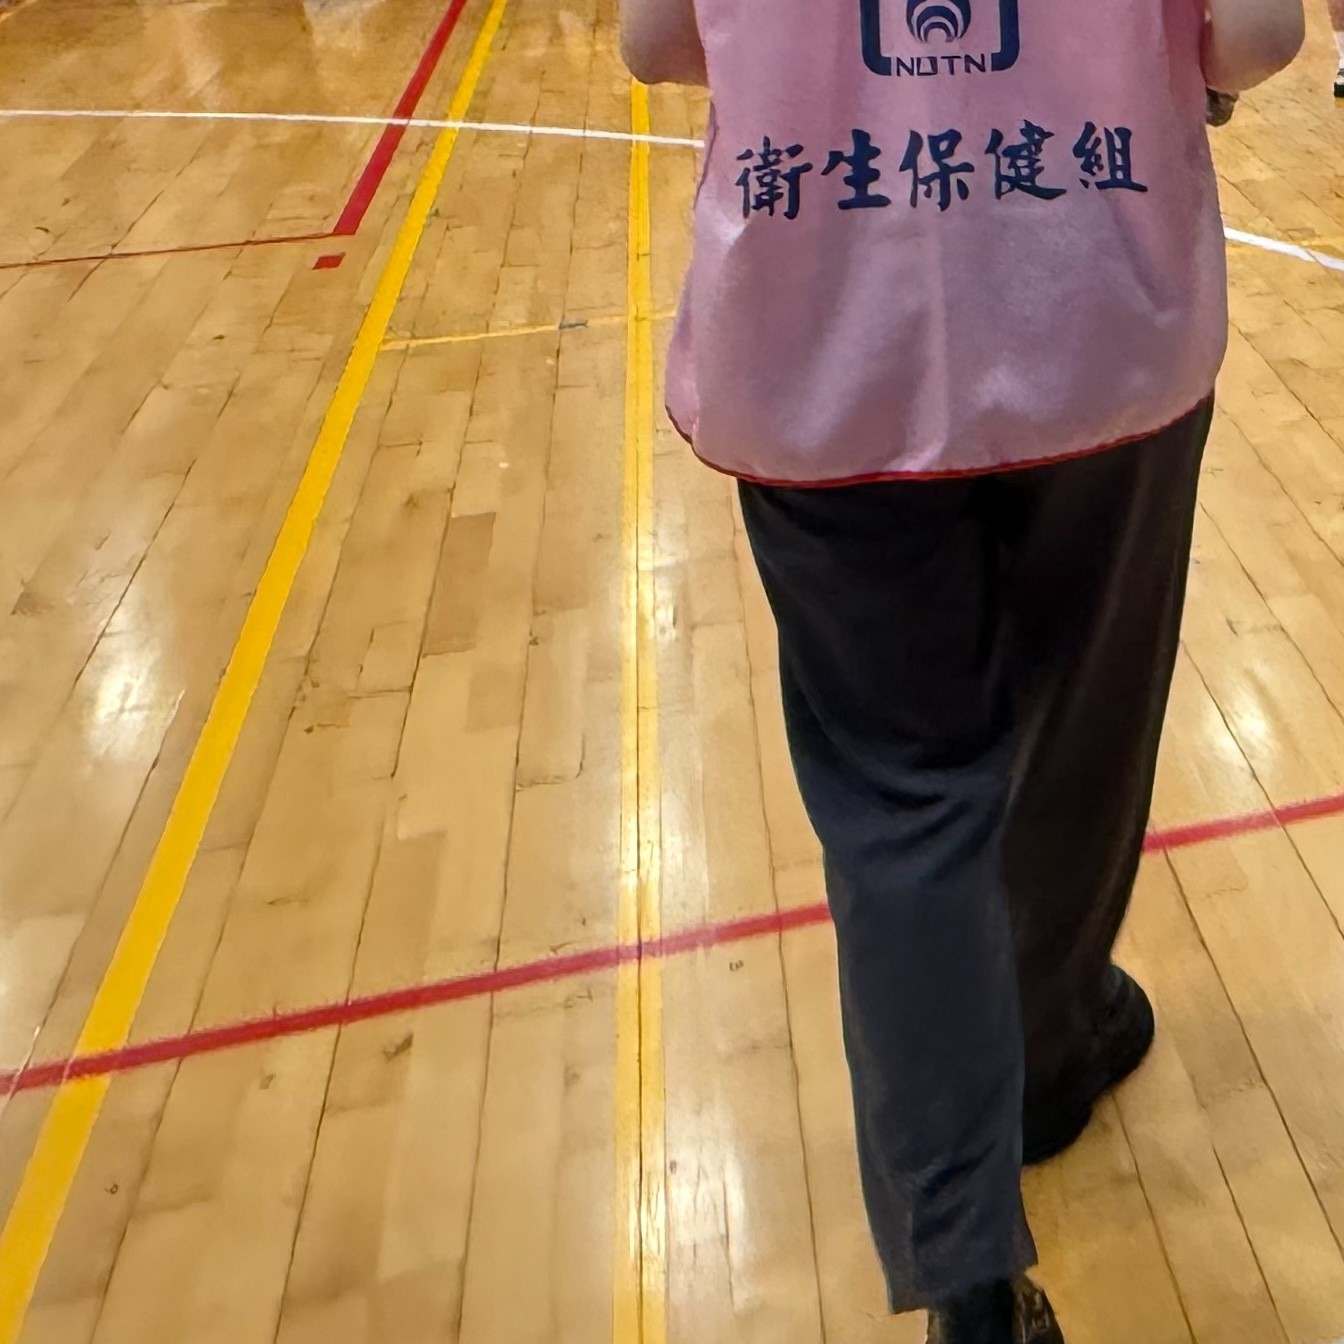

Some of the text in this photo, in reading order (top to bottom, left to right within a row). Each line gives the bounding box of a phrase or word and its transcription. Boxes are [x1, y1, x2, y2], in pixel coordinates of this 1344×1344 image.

[896, 53, 987, 78] NUTN
[735, 119, 1148, 220] 衛生保健組
